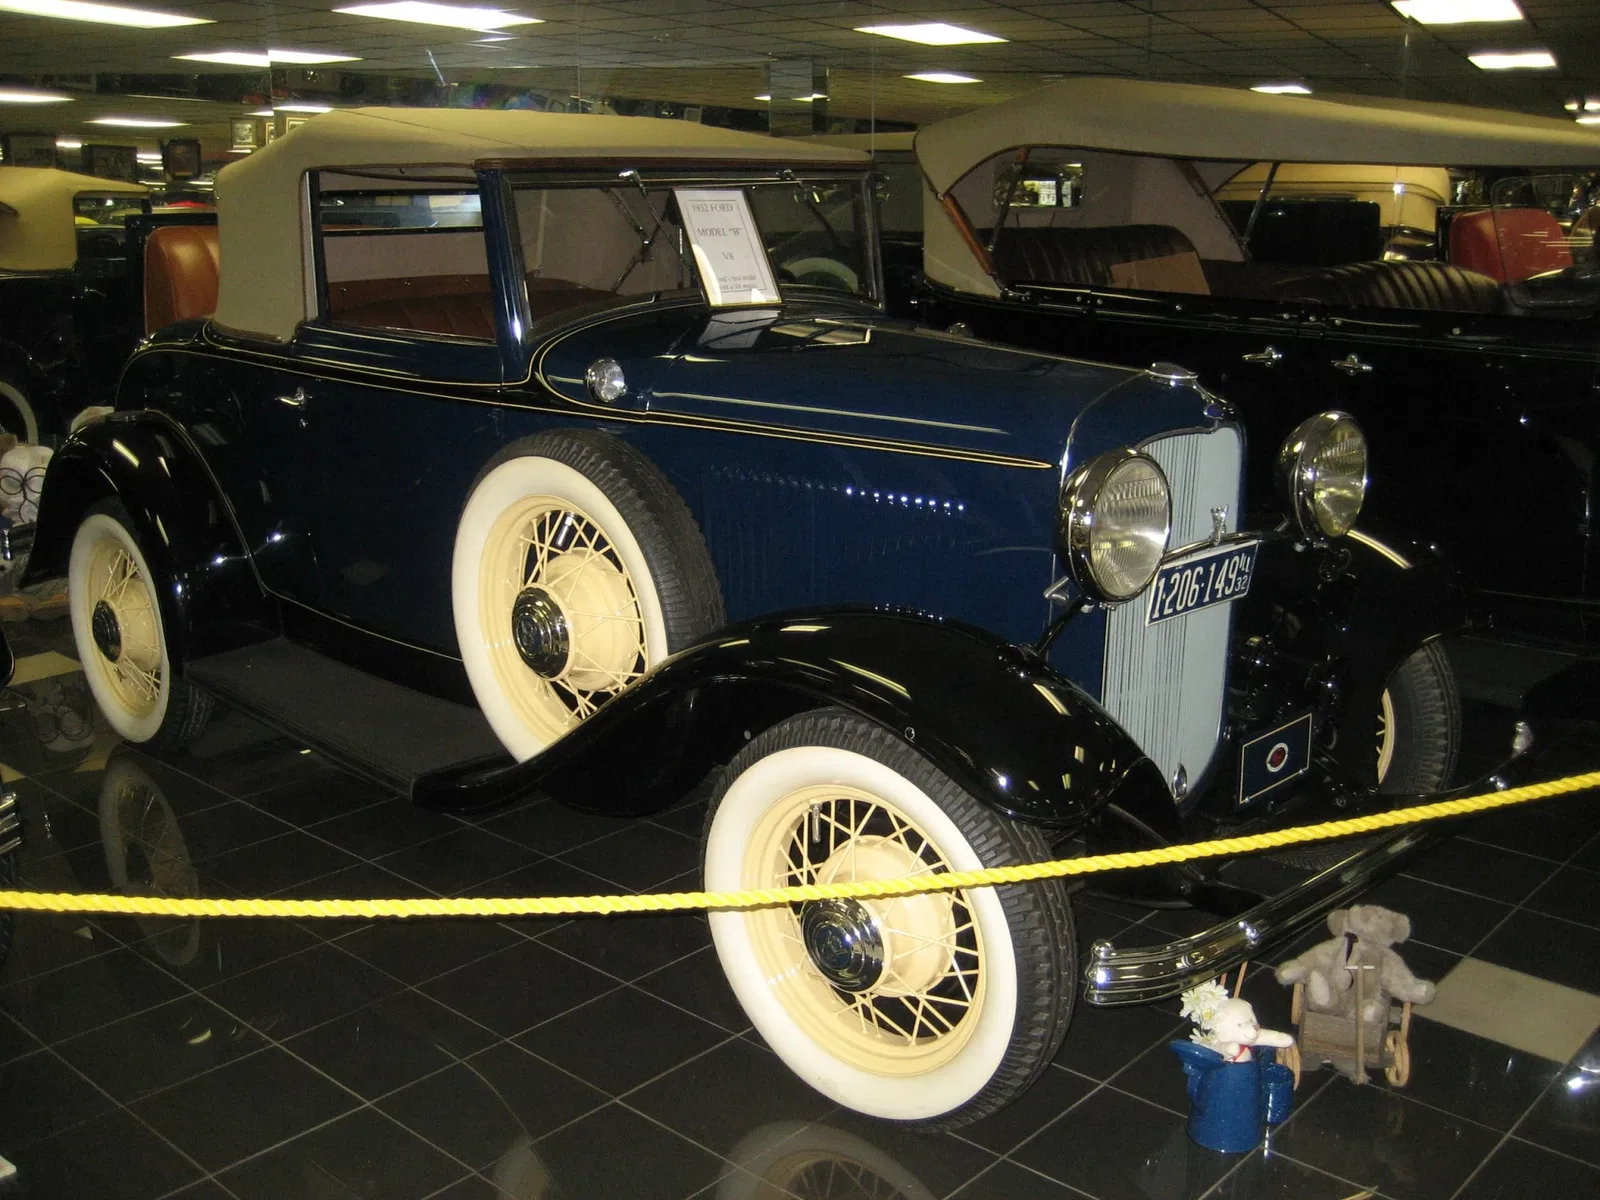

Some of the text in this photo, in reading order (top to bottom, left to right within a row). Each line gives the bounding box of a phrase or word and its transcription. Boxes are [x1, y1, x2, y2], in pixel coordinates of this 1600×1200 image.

[692, 203, 733, 212] 1932 FORD
[697, 227, 728, 236] MODEL
[721, 252, 734, 260] V8
[1235, 575, 1248, 592] 32
